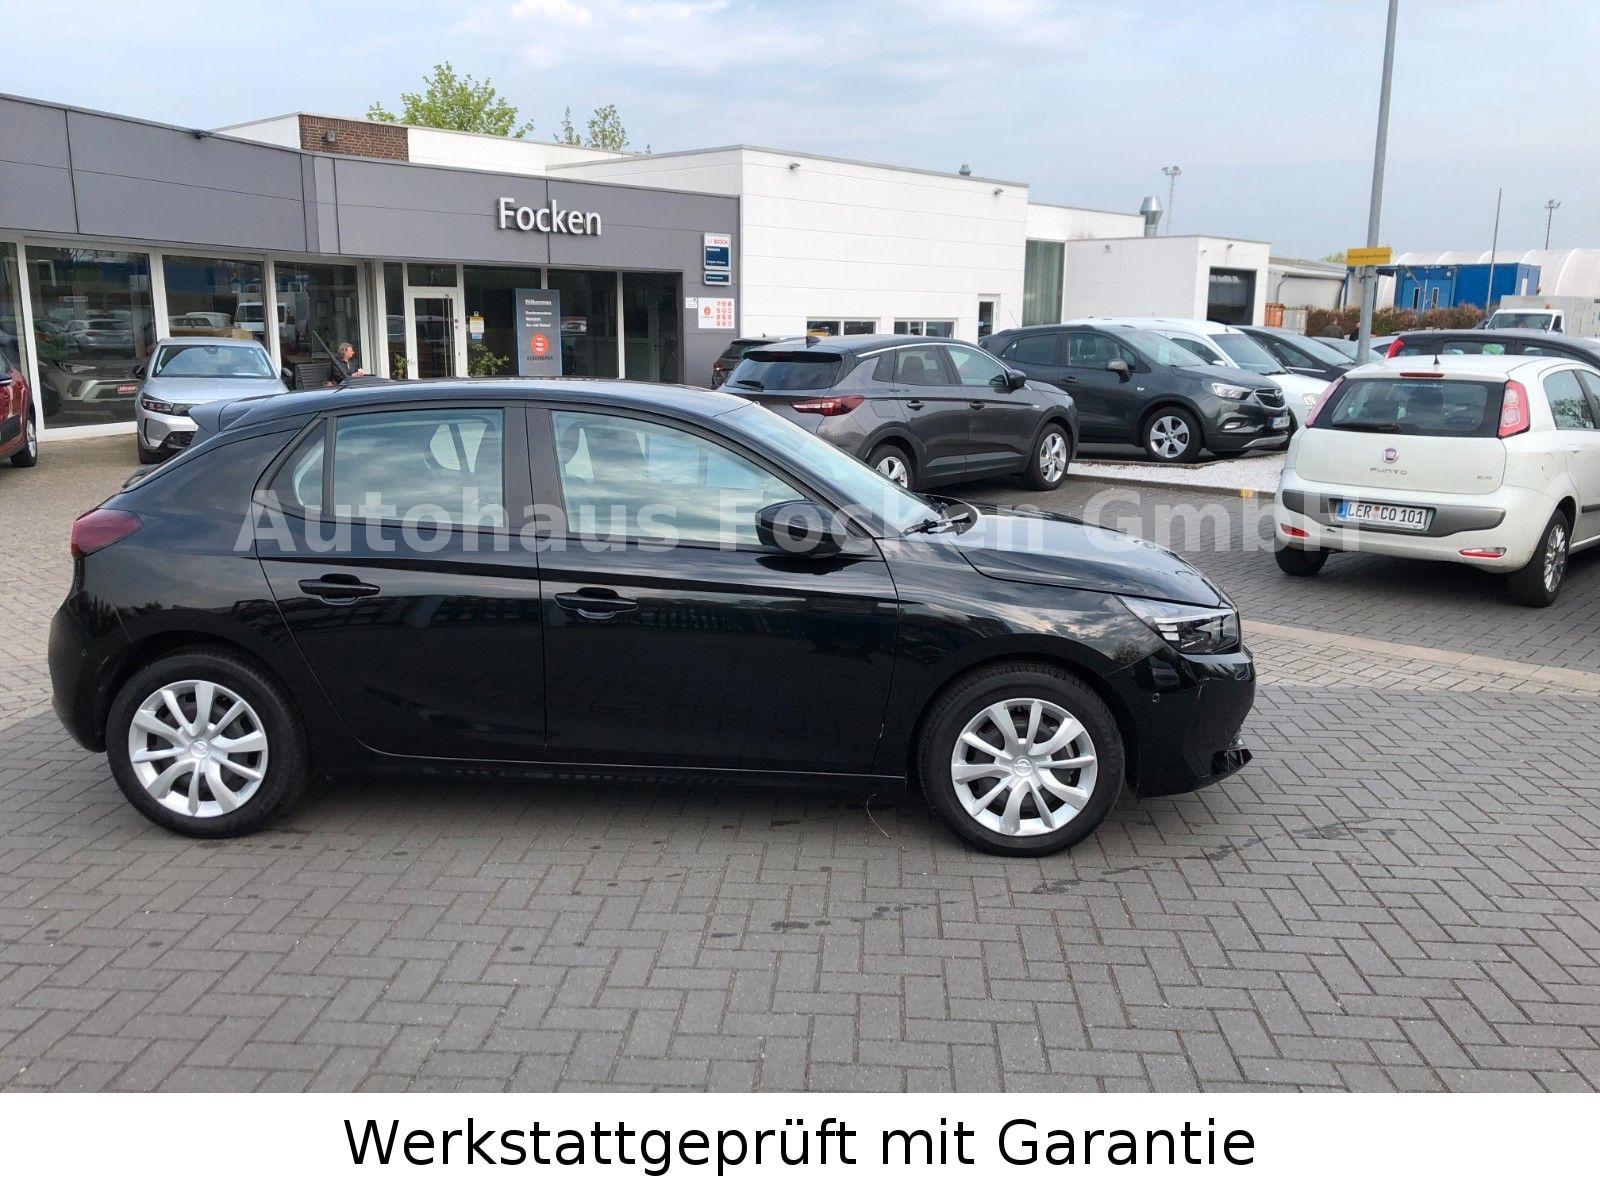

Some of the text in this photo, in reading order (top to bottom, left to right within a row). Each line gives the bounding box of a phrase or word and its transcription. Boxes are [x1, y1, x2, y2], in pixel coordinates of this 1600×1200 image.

[498, 197, 602, 236] Focken
[1369, 467, 1408, 475] PUNTO
[1347, 503, 1423, 524] LER CO 101
